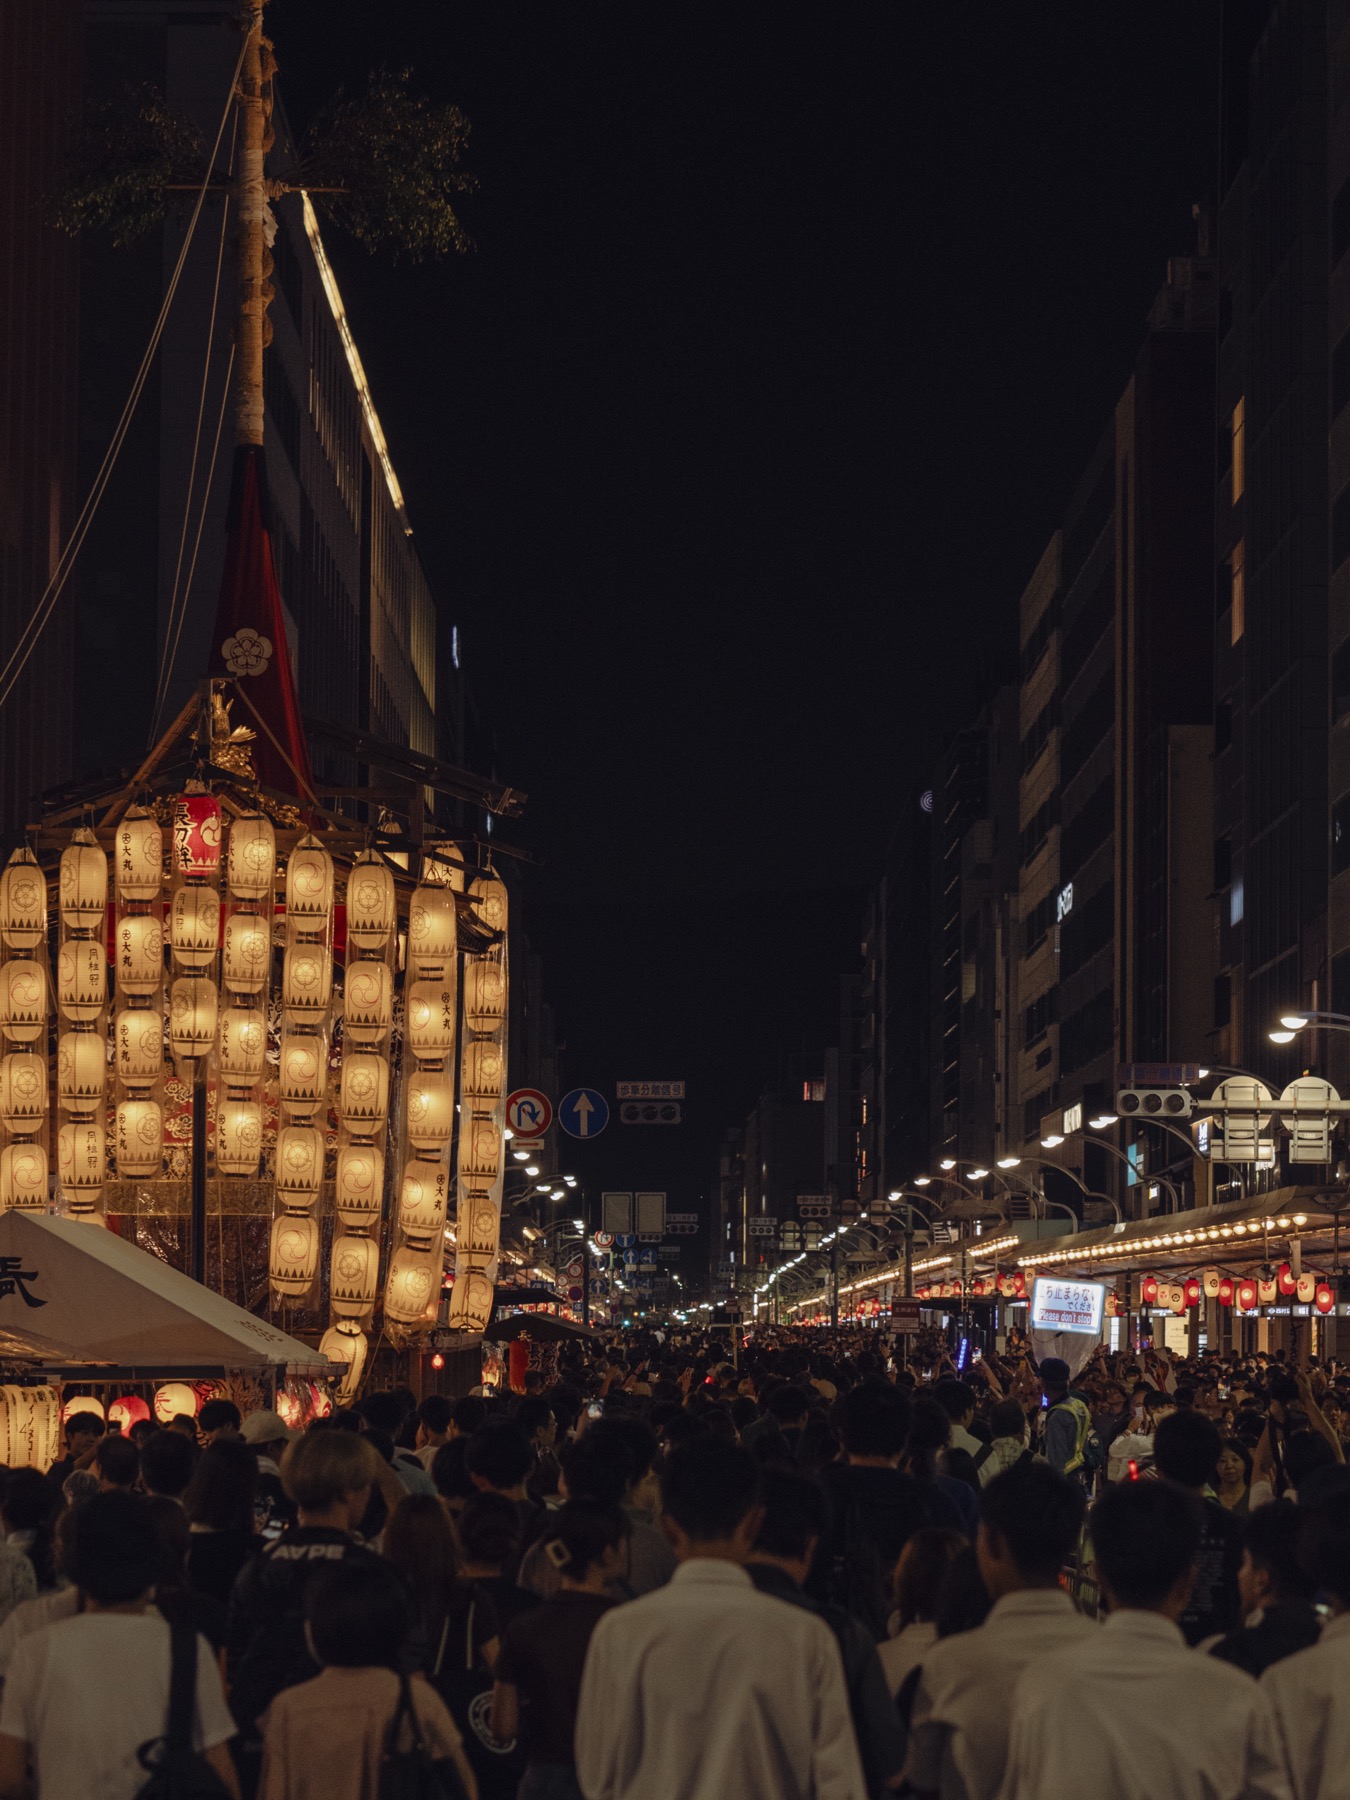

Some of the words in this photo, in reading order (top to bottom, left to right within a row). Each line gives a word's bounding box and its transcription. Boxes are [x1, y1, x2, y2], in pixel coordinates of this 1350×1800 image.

[175, 802, 195, 870] 長刀鉾
[122, 845, 133, 871] 大丸
[88, 948, 100, 986] 月桂冠
[121, 942, 133, 968] 大丸
[441, 1005, 451, 1031] 大丸
[120, 1037, 130, 1063] 大丸
[620, 1084, 682, 1096] 歩車分離信号
[118, 1125, 128, 1151] 大丸
[218, 1125, 227, 1151] 大丸
[434, 1186, 444, 1211] 大丸
[1040, 1310, 1059, 1321] Please
[1061, 1312, 1076, 1323] don't
[1078, 1314, 1091, 1325] stop
